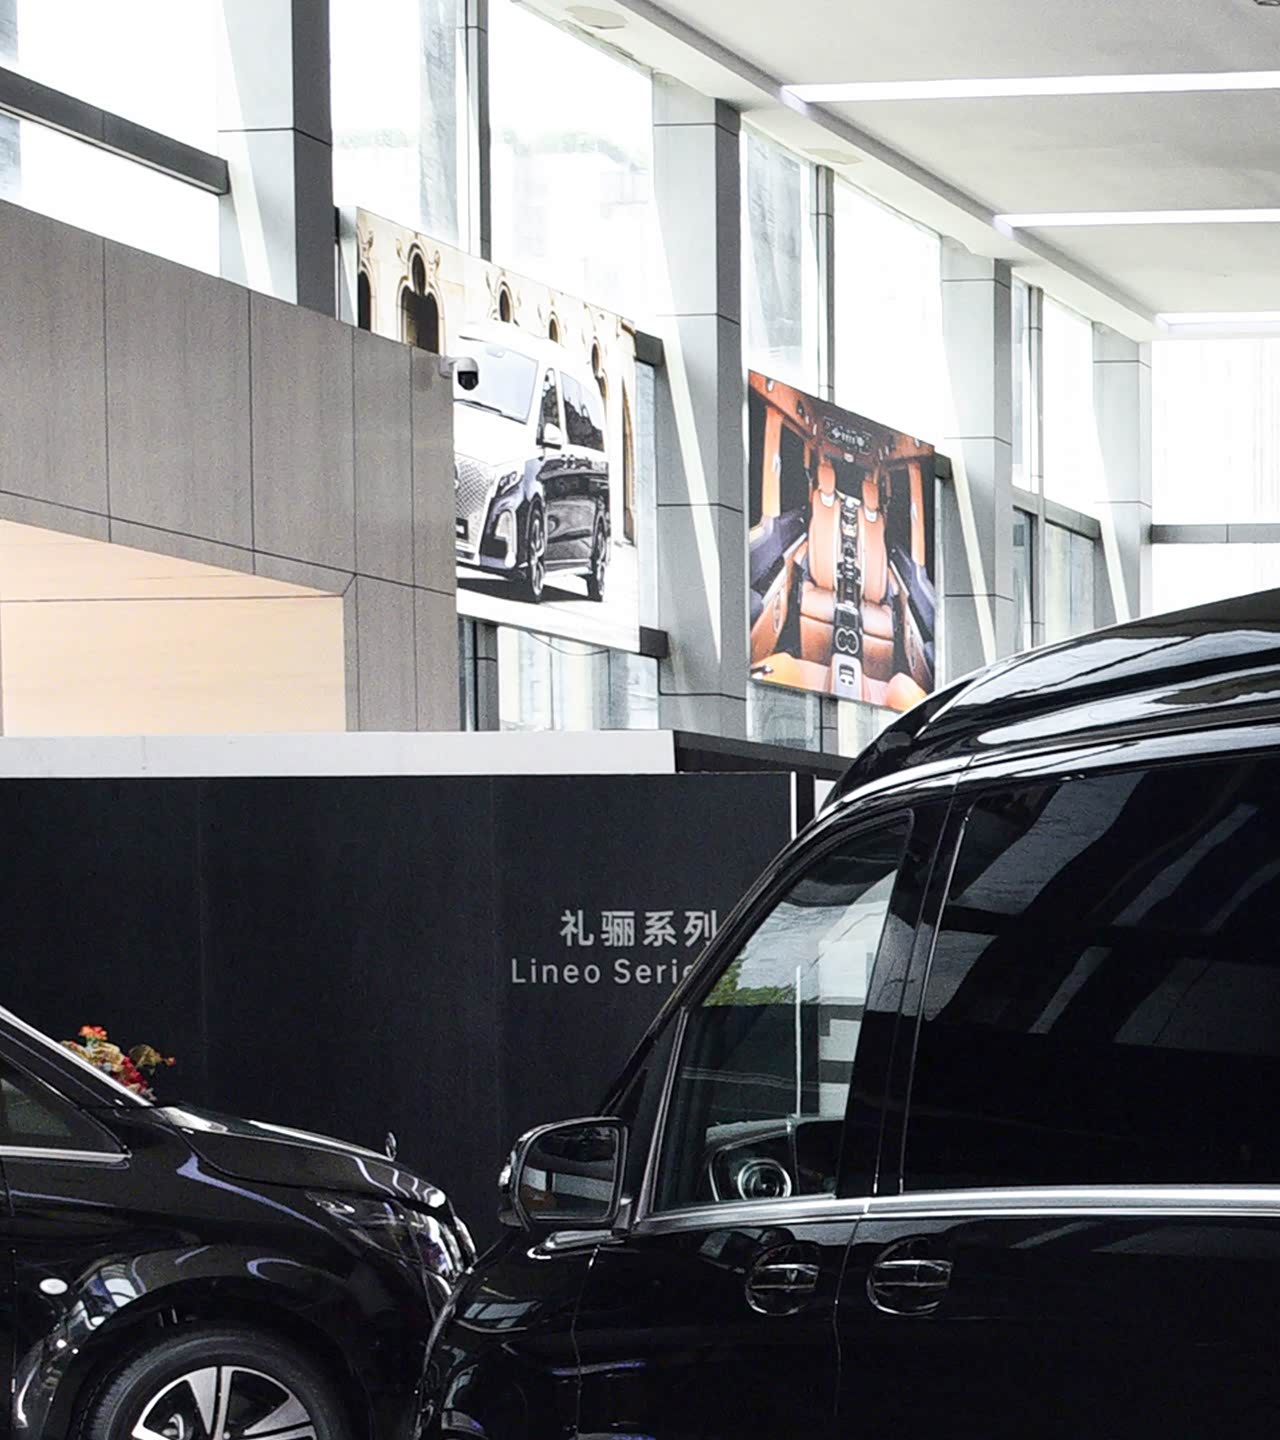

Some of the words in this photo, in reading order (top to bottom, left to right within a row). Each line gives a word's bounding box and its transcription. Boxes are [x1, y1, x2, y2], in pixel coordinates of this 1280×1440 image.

[559, 909, 718, 948] 礼骊系列
[511, 958, 601, 984] Lineo
